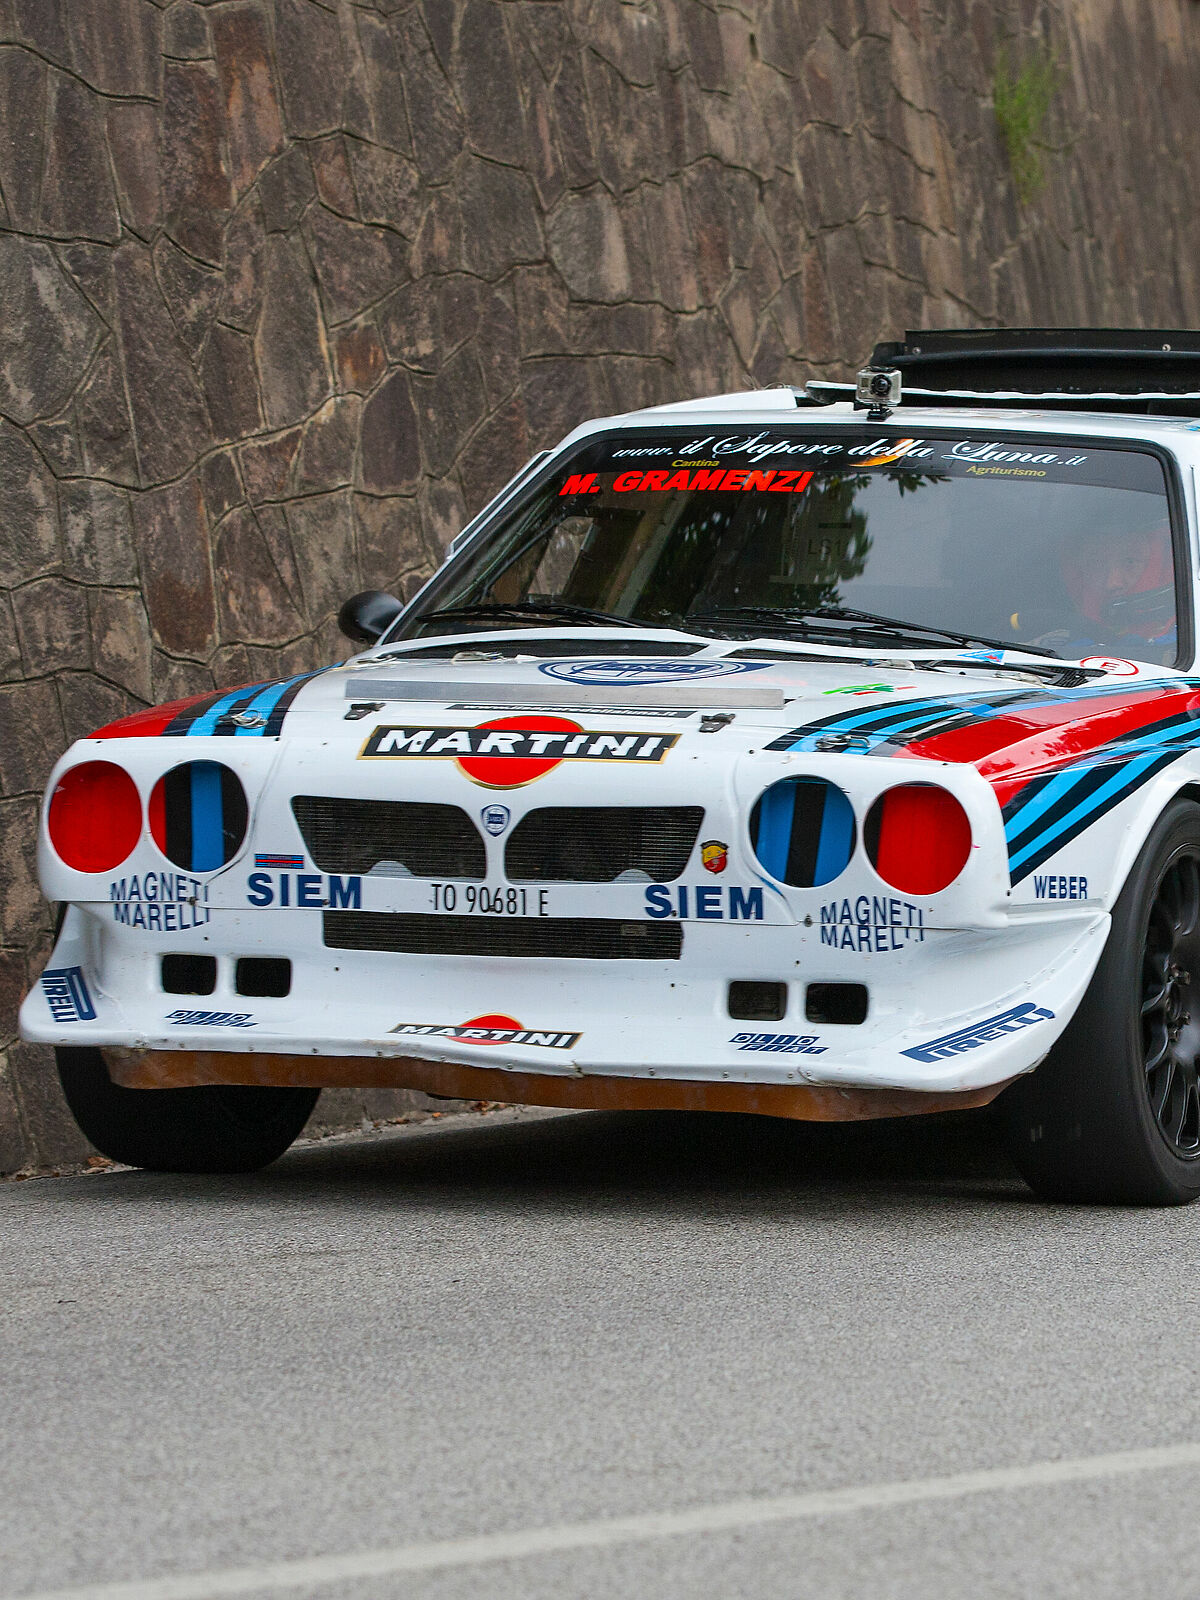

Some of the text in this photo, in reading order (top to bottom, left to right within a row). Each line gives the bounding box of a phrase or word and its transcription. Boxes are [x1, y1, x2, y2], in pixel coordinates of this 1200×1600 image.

[711, 430, 845, 463] Sapore
[847, 438, 936, 459] della
[672, 459, 720, 467] Cantina
[966, 465, 1047, 477] Agriturismo
[559, 470, 814, 496] M. GRAMENZI
[376, 729, 664, 758] MARTINI
[111, 871, 210, 903] MAGNETI
[247, 872, 362, 909] SIEM
[431, 884, 550, 917] TO 90681 E
[1034, 876, 1088, 900] WEBER
[114, 902, 210, 932] MARELLI
[644, 885, 764, 921] SIEM
[820, 895, 924, 929] MAGNETI
[820, 924, 924, 953] MARELLI
[41, 966, 97, 1023] PIRELLI
[398, 1025, 574, 1047] MARTINI
[729, 1033, 820, 1046] OLIO
[899, 1002, 1056, 1063] PIRELLI
[737, 1044, 829, 1055] FIAT
